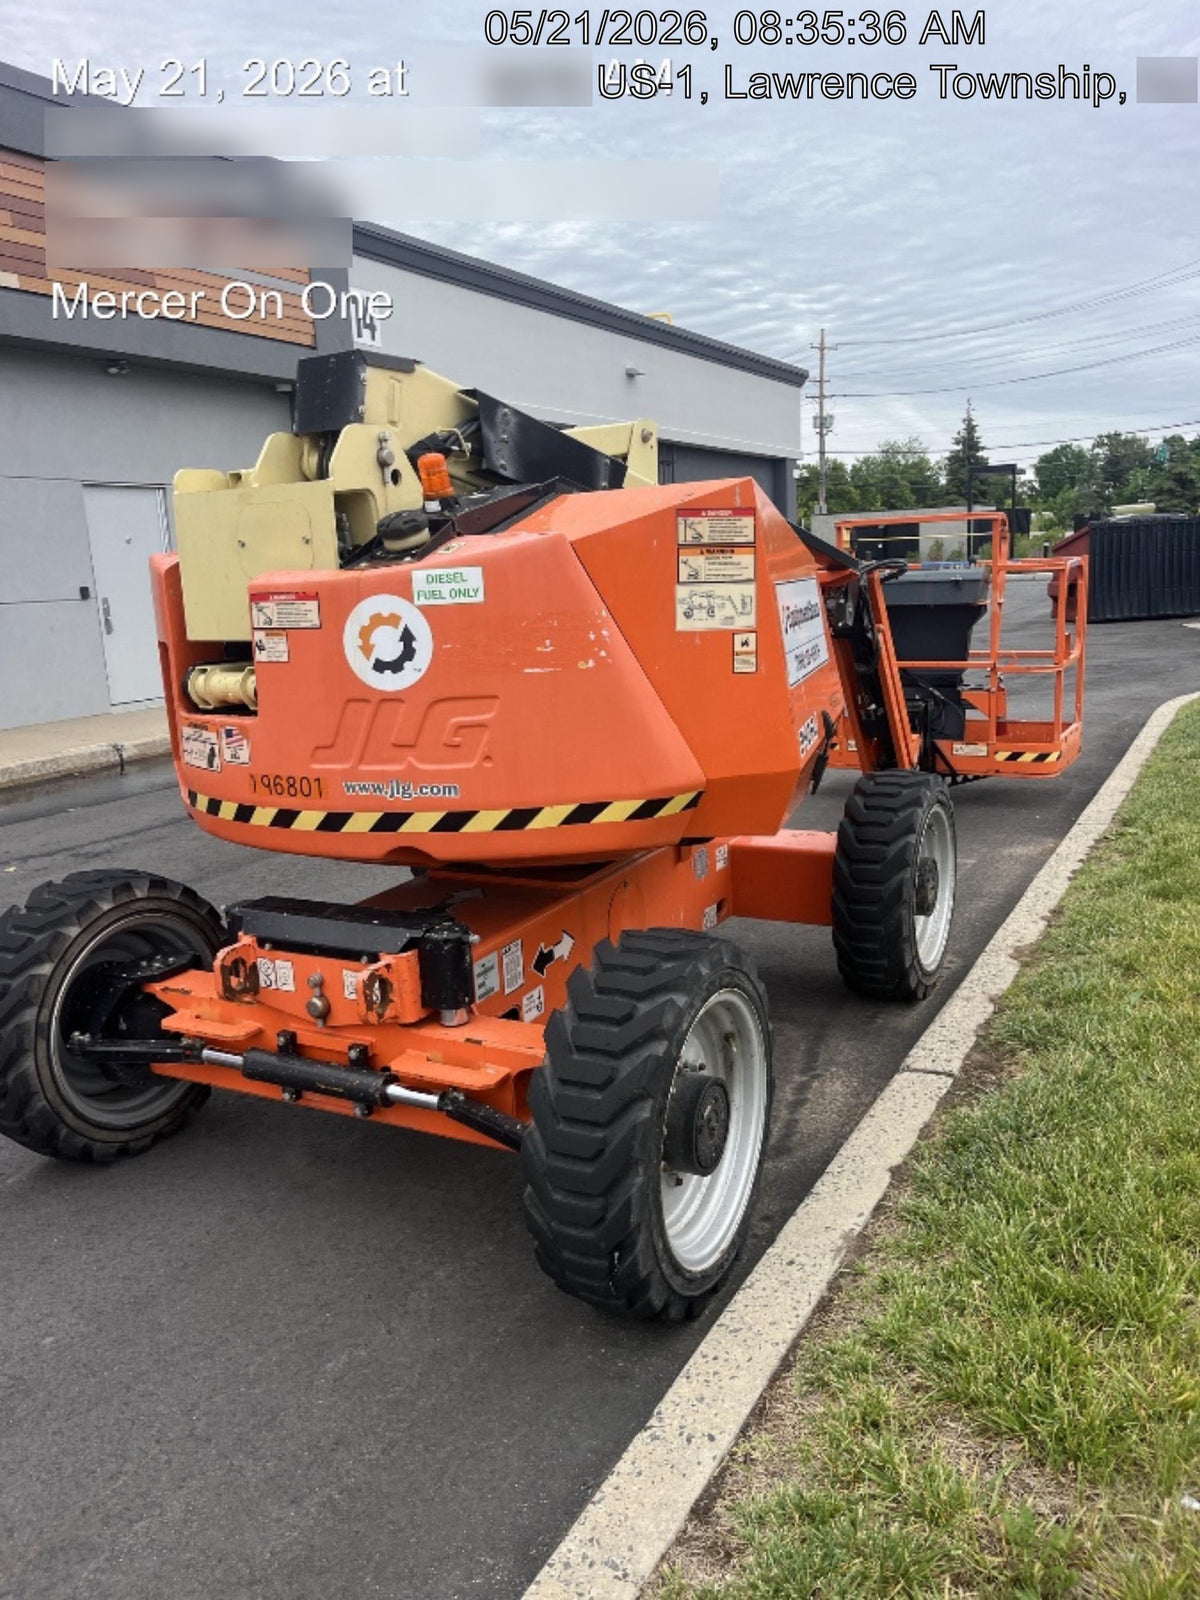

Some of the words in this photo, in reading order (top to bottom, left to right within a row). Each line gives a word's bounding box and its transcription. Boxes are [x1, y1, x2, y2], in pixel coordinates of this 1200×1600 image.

[426, 572, 468, 585] DIESEL
[417, 590, 446, 601] FUEL
[449, 587, 479, 600] ONLY
[343, 780, 459, 799] www.jlg.com
